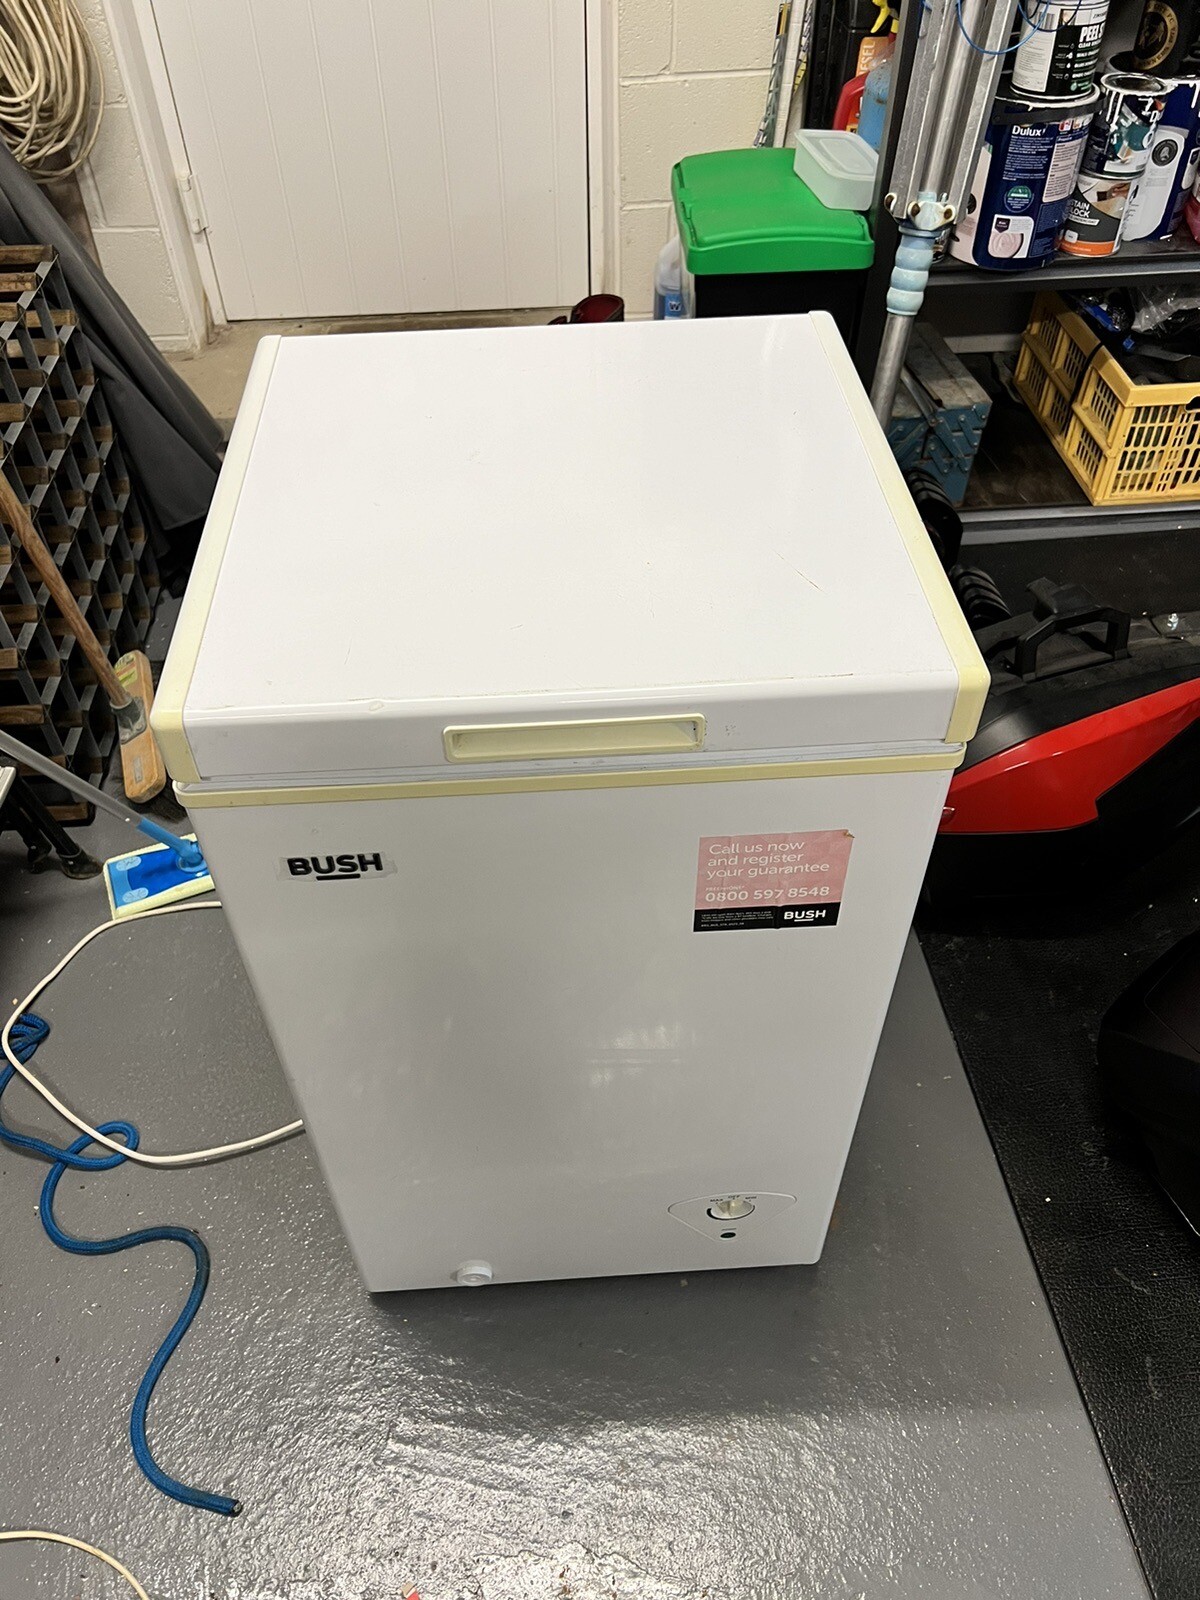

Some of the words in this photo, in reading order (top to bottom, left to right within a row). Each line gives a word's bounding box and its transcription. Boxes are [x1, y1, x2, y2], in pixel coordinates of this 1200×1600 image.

[1079, 25, 1099, 42] PEEL
[1011, 125, 1042, 137] Dulux
[709, 843, 740, 855] Call
[744, 843, 763, 853] us
[767, 841, 805, 852] now
[287, 853, 383, 878] BUSH
[708, 855, 738, 867] and
[742, 852, 804, 868] register
[707, 868, 743, 880] your
[748, 863, 830, 878] guarantee
[705, 890, 749, 902] 0800
[753, 888, 783, 900] 597
[787, 886, 830, 898] 8548
[784, 910, 826, 921] BUSH
